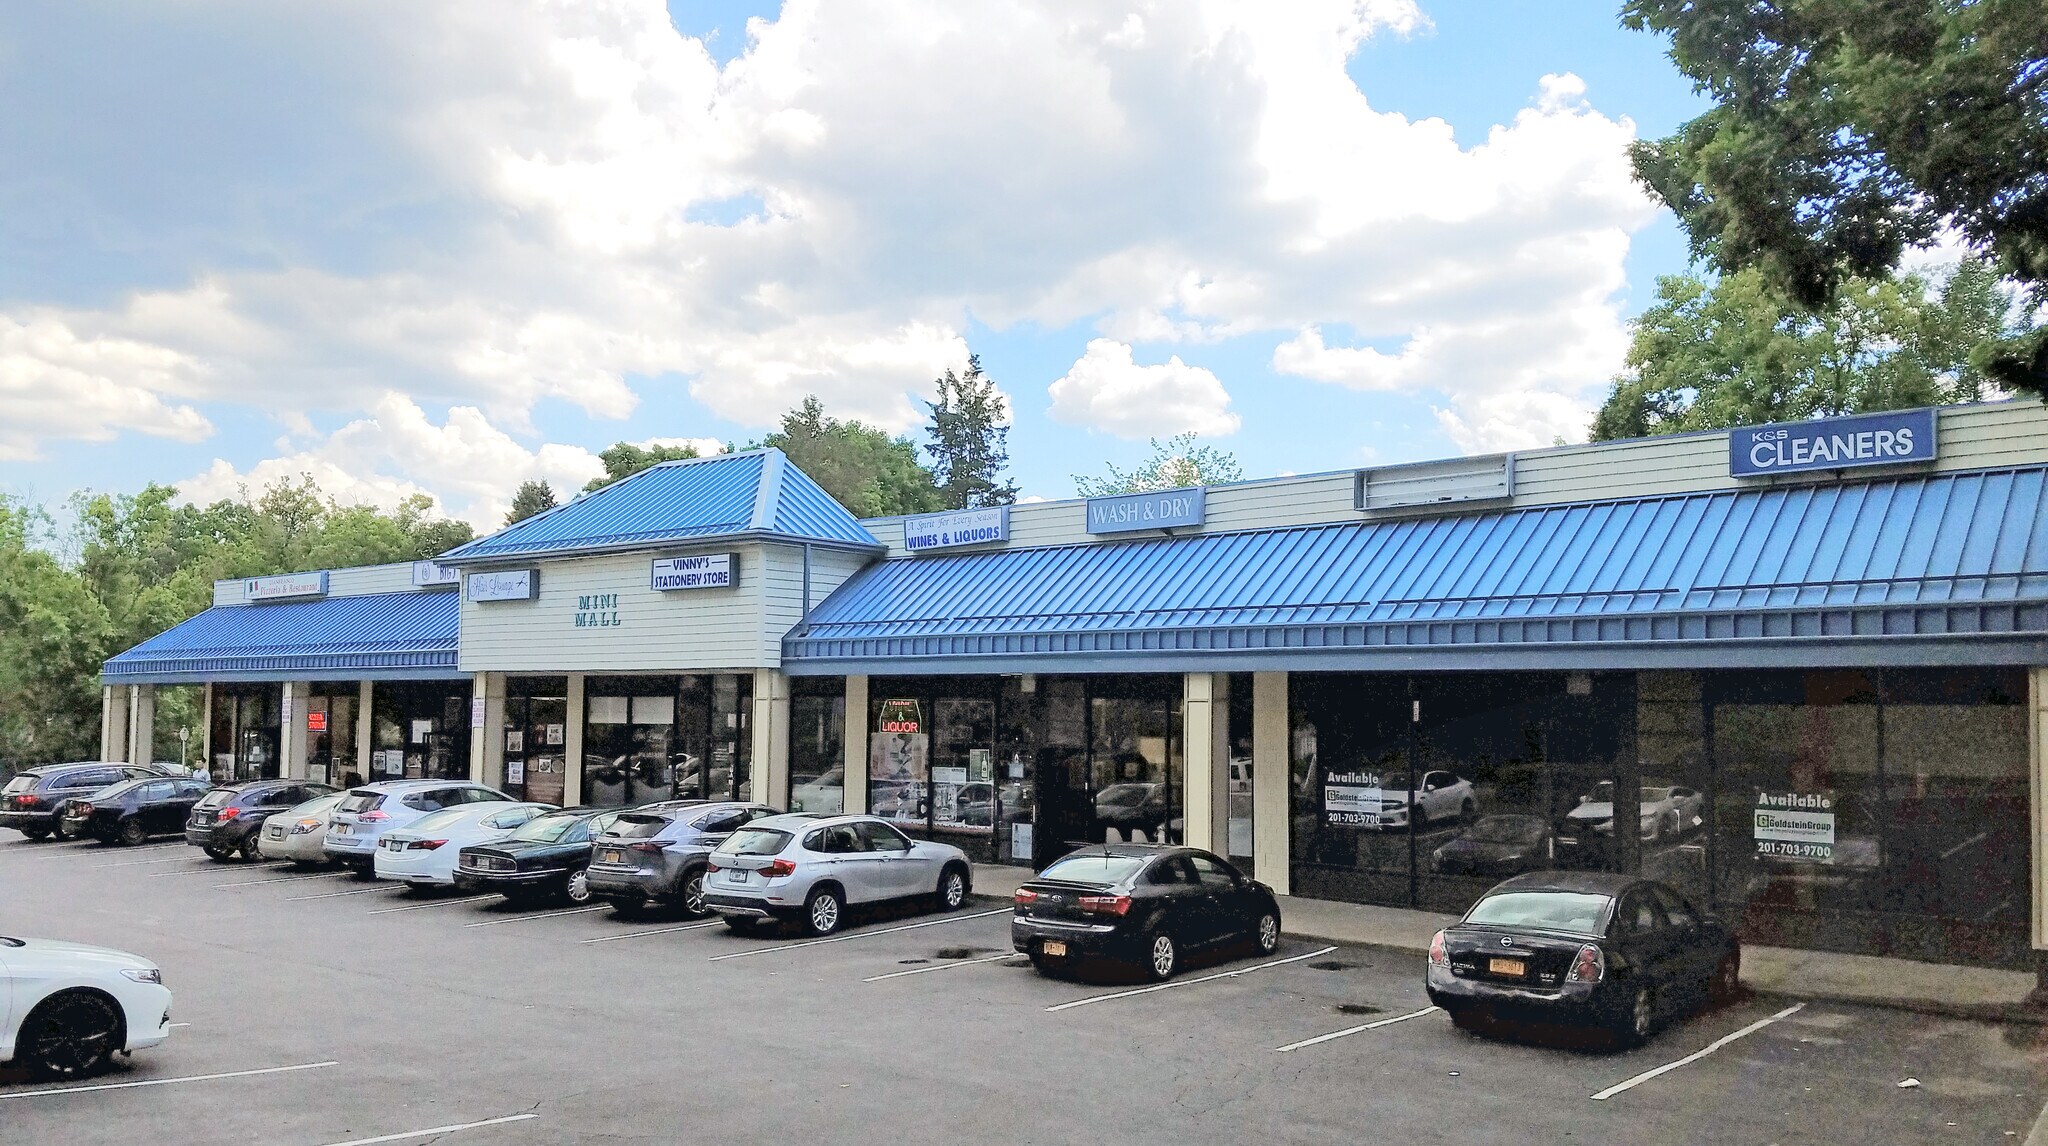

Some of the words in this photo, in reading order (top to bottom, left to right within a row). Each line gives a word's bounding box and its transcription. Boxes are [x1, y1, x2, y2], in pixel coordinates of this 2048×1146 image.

[1751, 429, 1789, 442] K&S
[1749, 427, 1914, 468] CLEANERS
[1092, 502, 1138, 525] WASH
[1143, 501, 1155, 521] &
[1159, 497, 1193, 519] DRY
[917, 520, 935, 532] Spirit
[952, 515, 972, 527] Every
[975, 512, 998, 523] Season
[908, 533, 938, 549] WINES
[942, 532, 950, 545] &
[954, 526, 1000, 543] LIQUORS
[673, 557, 710, 571] VINNY'S
[489, 574, 514, 597] Lounge
[655, 572, 702, 588] STATIONERY
[703, 571, 728, 585] STORE
[282, 584, 288, 594] &
[289, 583, 318, 593] Restaurant
[578, 593, 617, 610] MINI
[575, 611, 621, 627] MALL
[898, 711, 905, 721] &
[882, 721, 918, 733] LIQUOR
[1328, 771, 1379, 784] Available
[1759, 792, 1831, 808] Available
[1328, 812, 1380, 824] 201-703-9700
[1769, 819, 1832, 831] GoldsteinGroup
[1758, 841, 1831, 857] 201-703-9700
